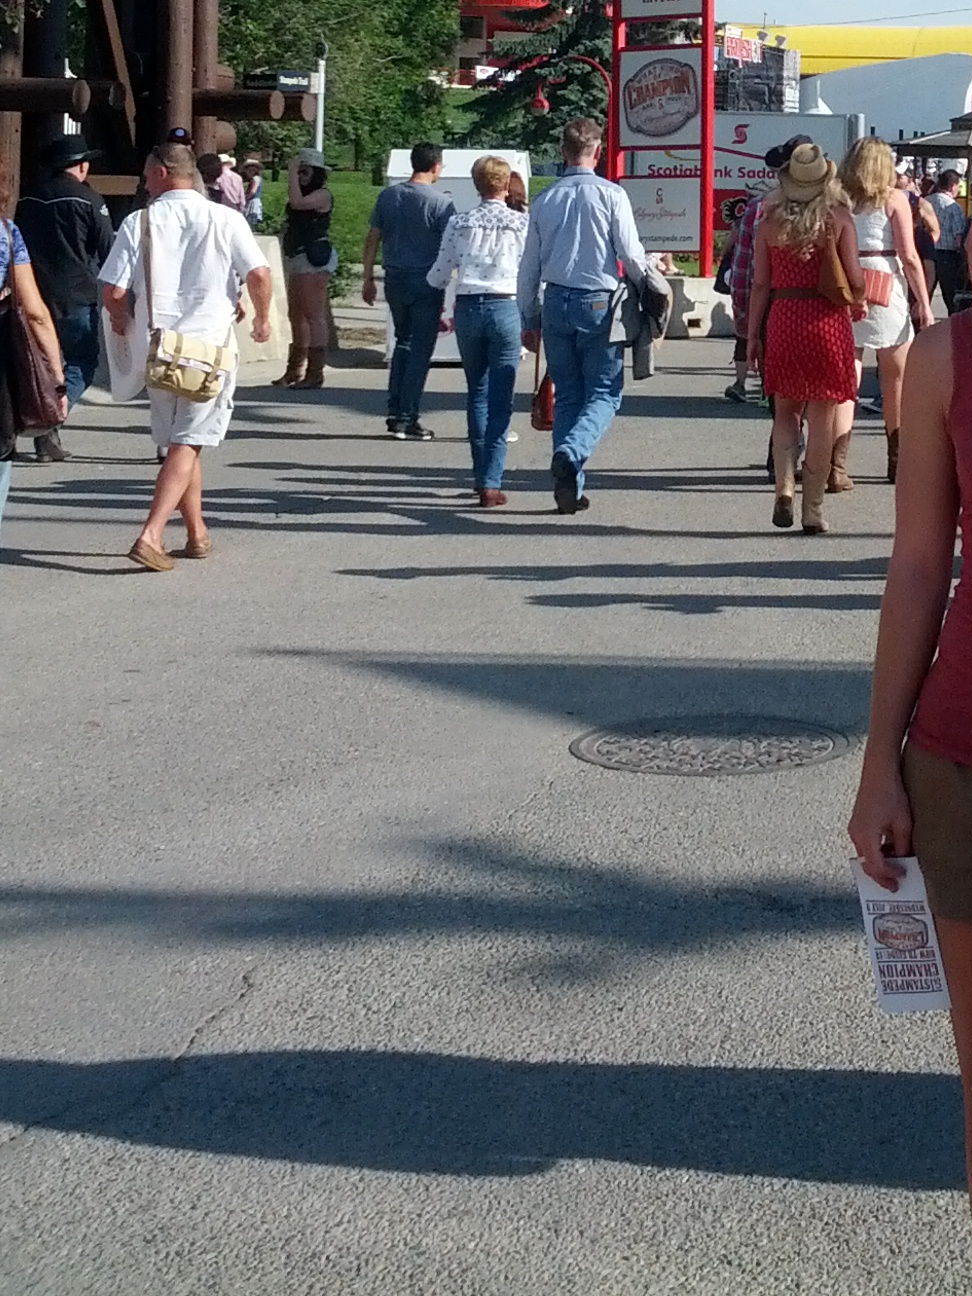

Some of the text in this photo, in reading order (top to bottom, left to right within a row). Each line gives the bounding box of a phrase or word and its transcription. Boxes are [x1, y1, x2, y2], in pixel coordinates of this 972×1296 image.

[626, 68, 690, 111] CHAMPION
[647, 164, 732, 178] Scotiabnk
[878, 962, 939, 979] CHAMPION
[880, 978, 931, 992] STAMPEDE
